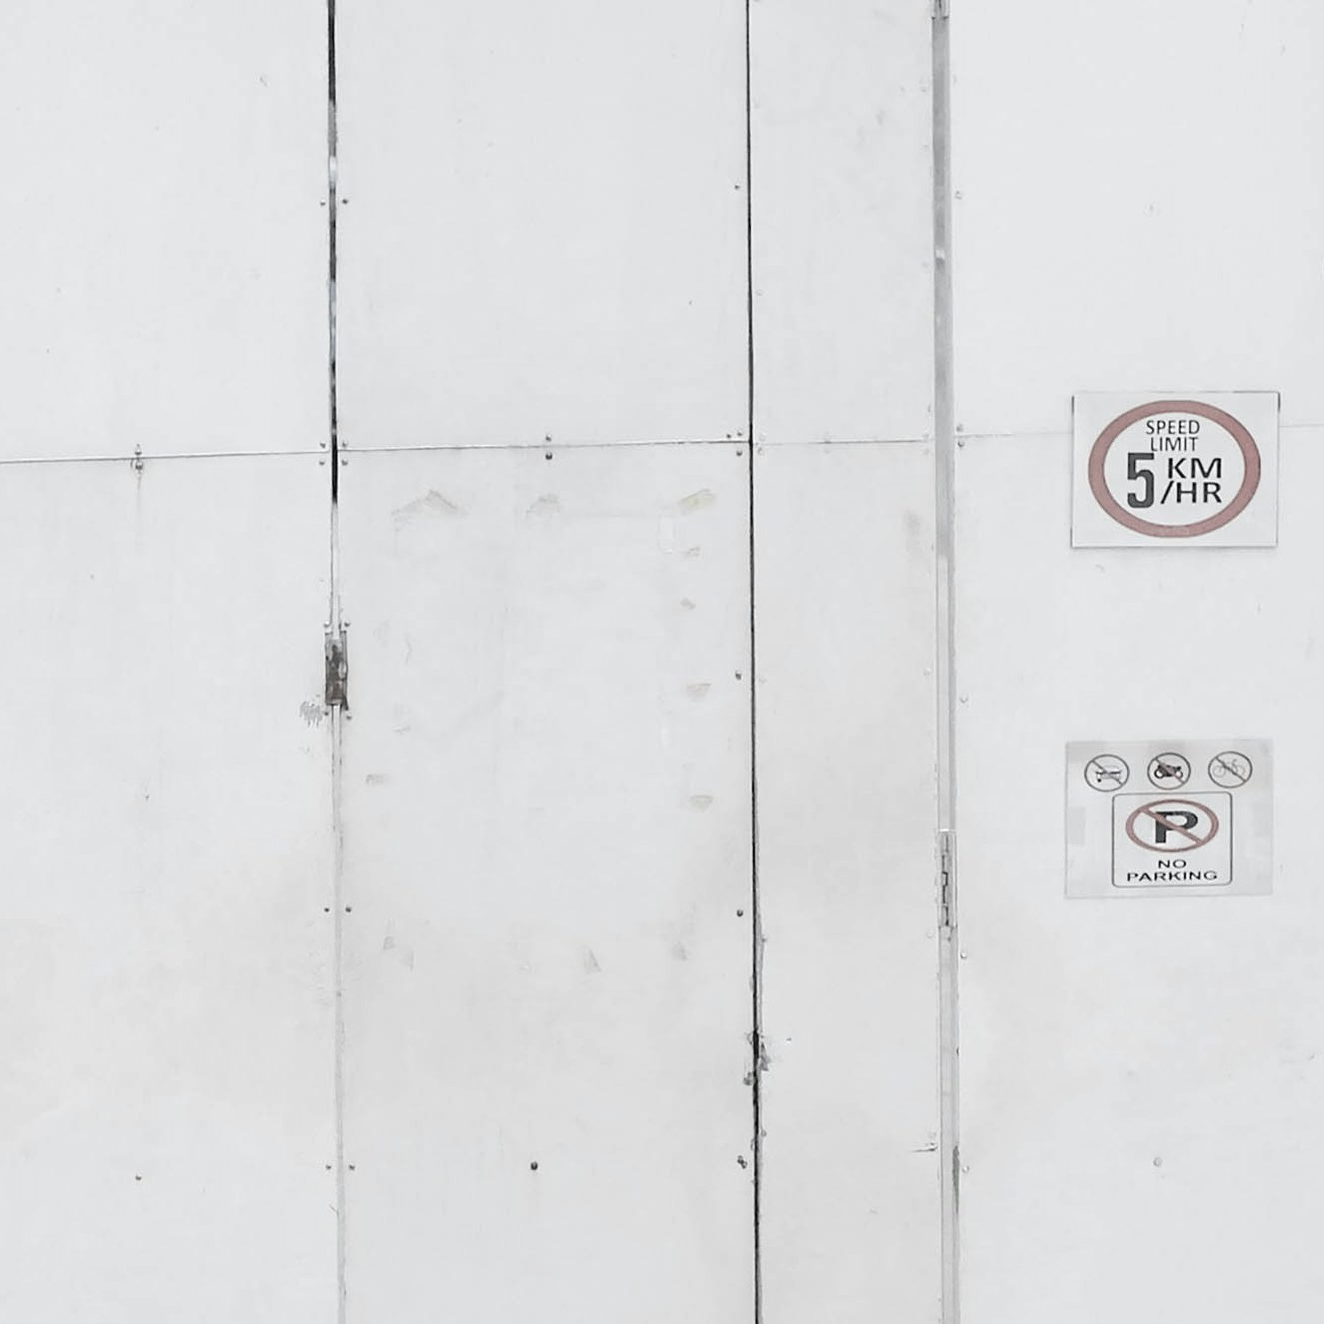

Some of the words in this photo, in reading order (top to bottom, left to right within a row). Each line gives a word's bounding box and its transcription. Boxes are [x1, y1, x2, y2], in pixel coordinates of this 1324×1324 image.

[1146, 420, 1200, 435] SPEED
[1150, 436, 1199, 452] LIMIT
[1127, 452, 1154, 508] 5
[1167, 457, 1222, 479] KM
[1160, 480, 1222, 504] /HR
[1157, 859, 1187, 869] NO
[1126, 870, 1218, 882] PARKING
